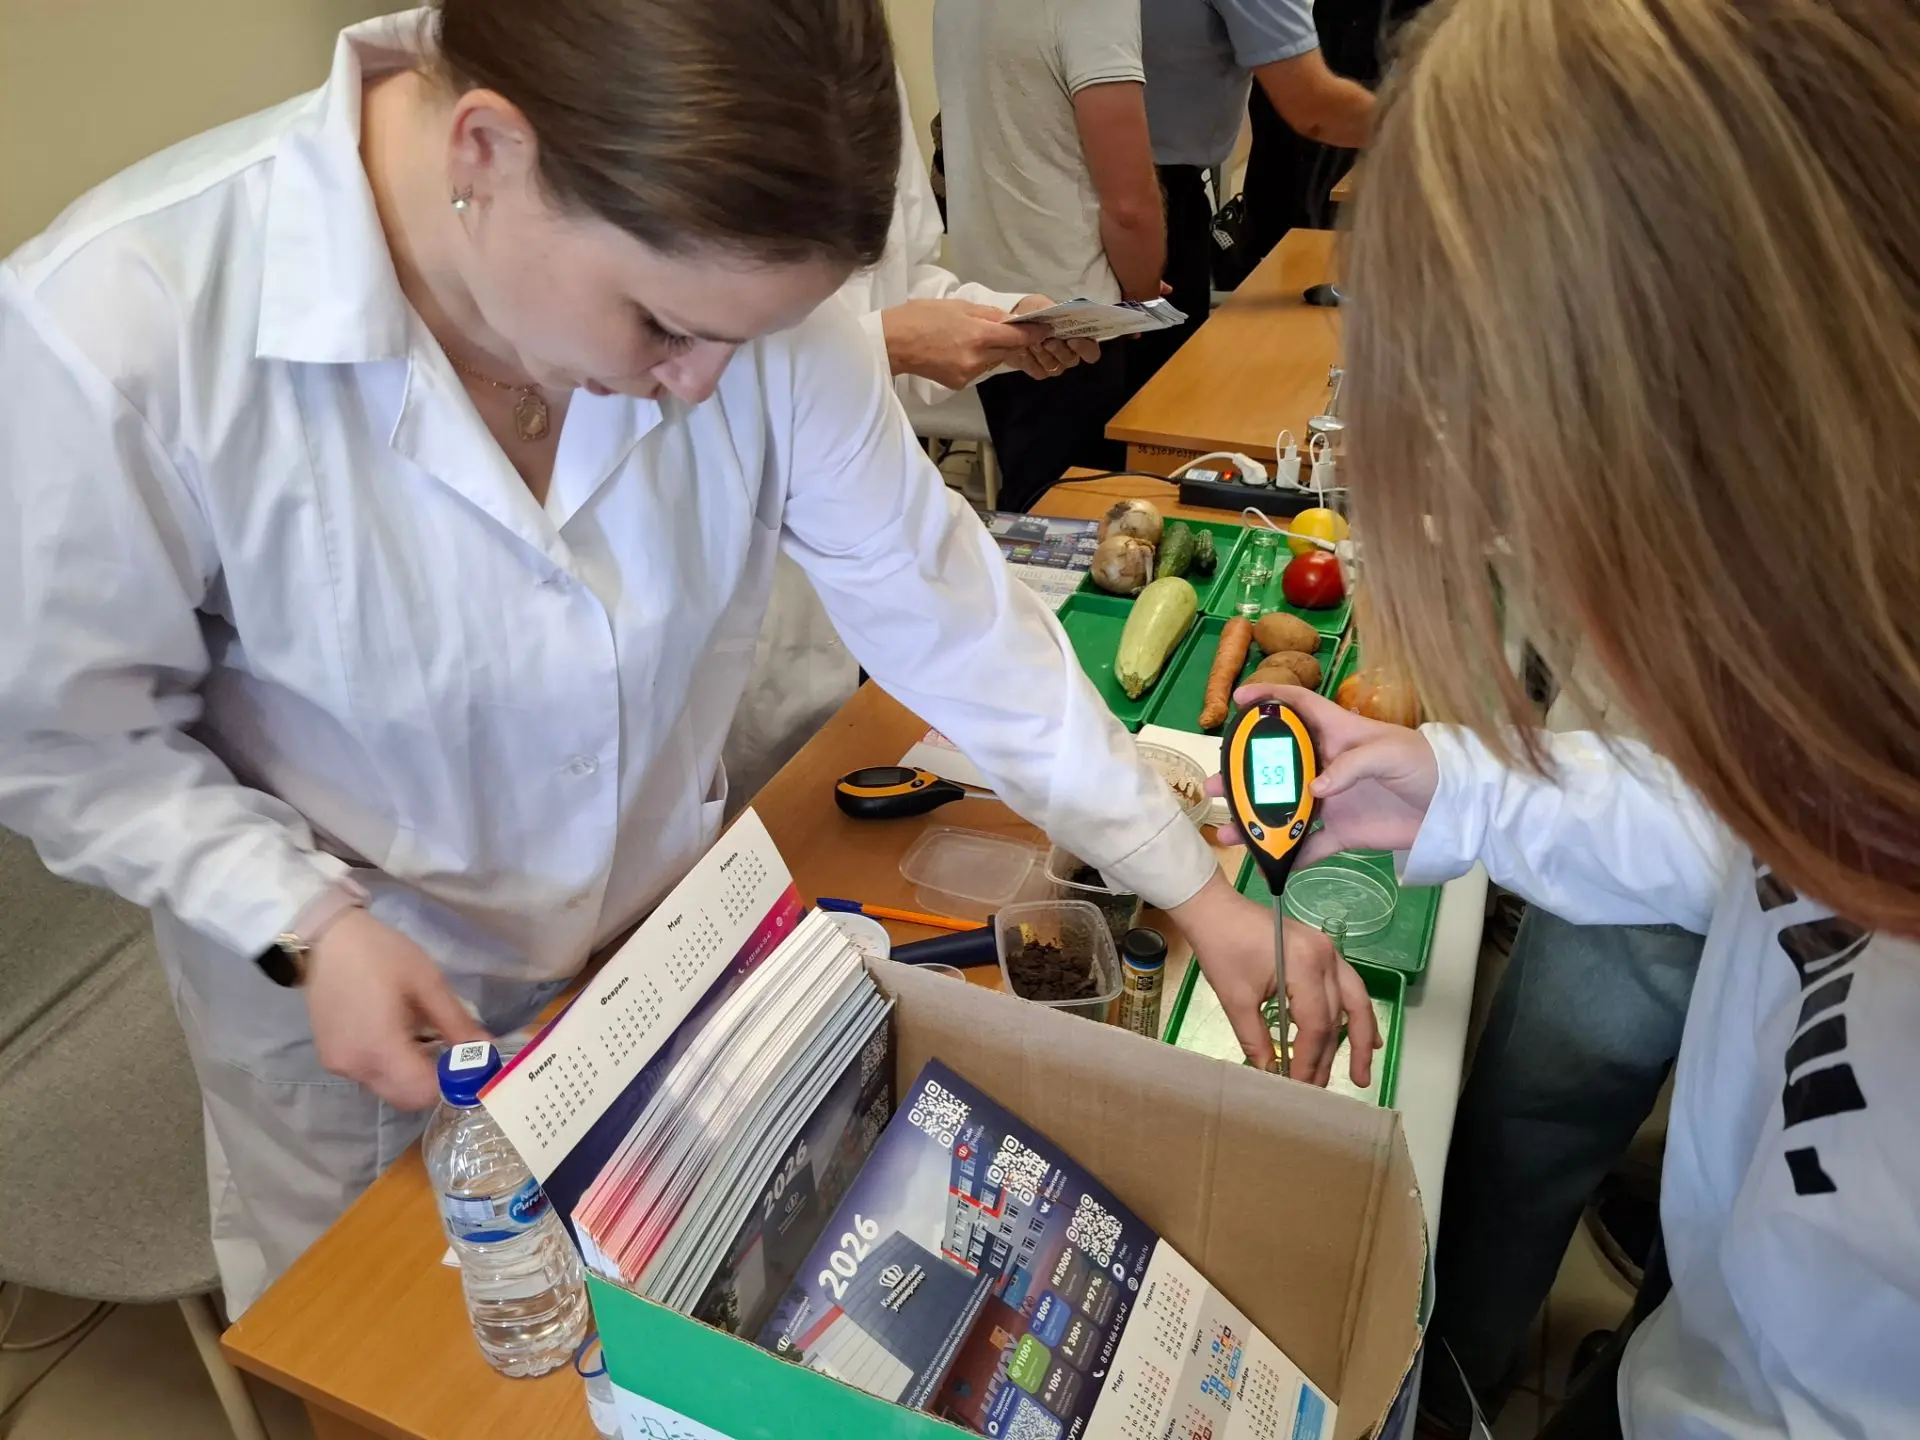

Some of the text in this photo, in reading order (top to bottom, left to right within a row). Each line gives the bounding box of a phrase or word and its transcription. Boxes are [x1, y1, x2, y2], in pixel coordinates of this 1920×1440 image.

[720, 852, 738, 872] Апрель
[668, 914, 682, 932] Март
[600, 976, 629, 1005] Февраль
[528, 1053, 557, 1082] Январь
[763, 1139, 807, 1221] 2026
[818, 1213, 879, 1300] 2026
[1056, 1246, 1073, 1277] 5000+
[1087, 1287, 1097, 1301] 97
[1142, 1282, 1156, 1309] Апрель
[1037, 1296, 1052, 1322] 800+
[1068, 1320, 1083, 1347] 300+
[1100, 1302, 1127, 1364] 8 831 66 4-15-47
[1191, 1329, 1203, 1356] Август
[1016, 1338, 1033, 1368] 1100+
[1049, 1368, 1063, 1392] 100+
[1112, 1368, 1125, 1392] Март
[1237, 1367, 1249, 1401] Декабрь
